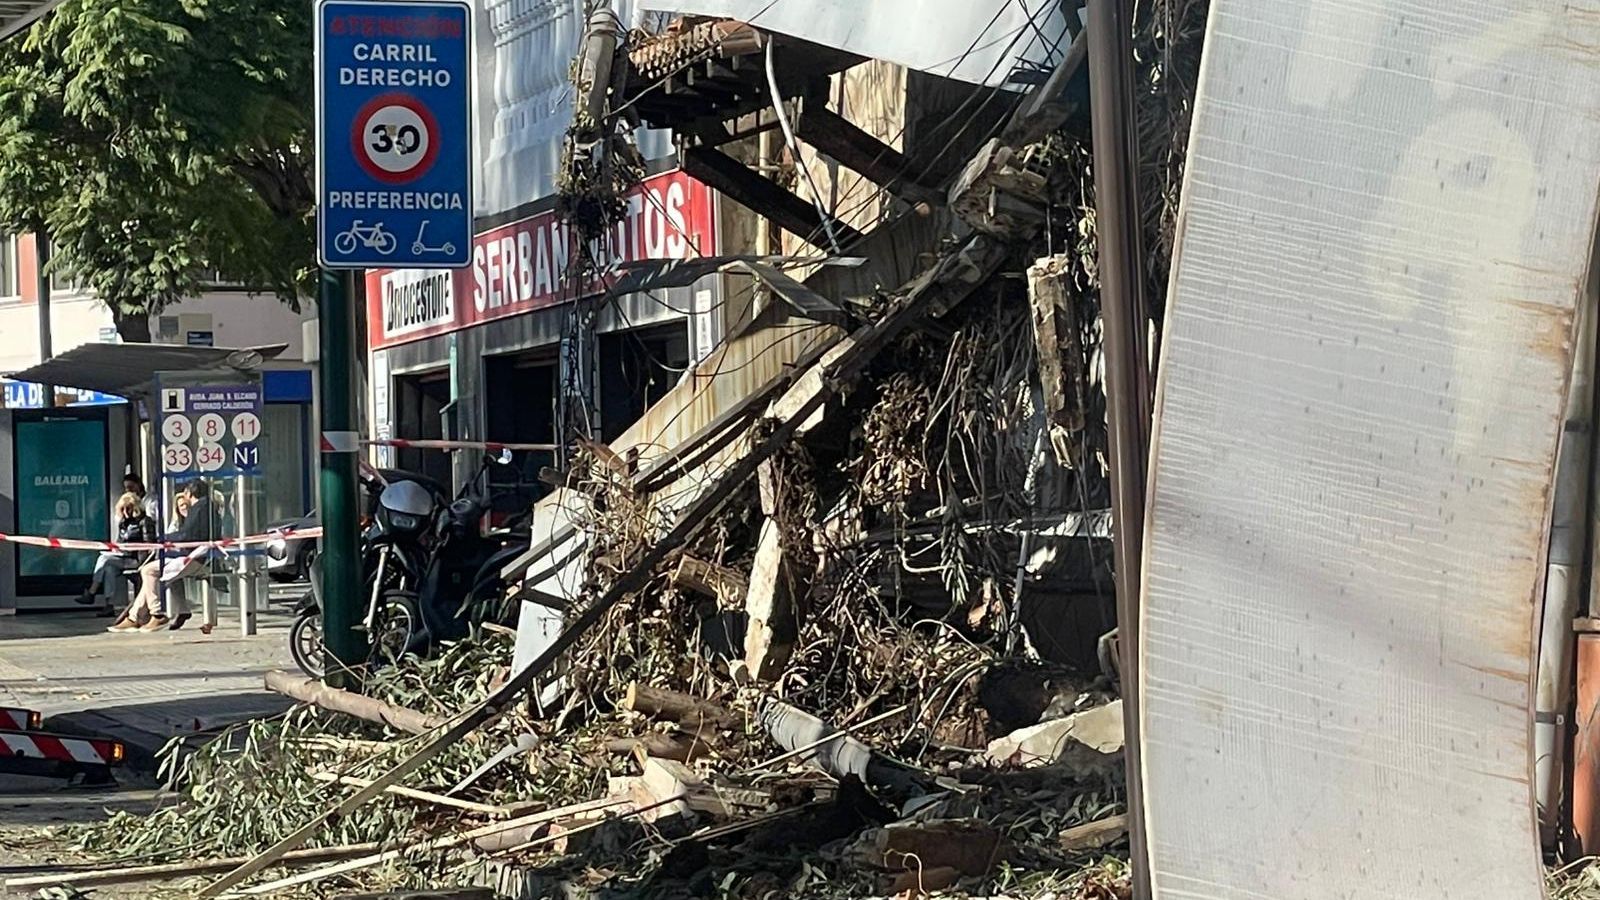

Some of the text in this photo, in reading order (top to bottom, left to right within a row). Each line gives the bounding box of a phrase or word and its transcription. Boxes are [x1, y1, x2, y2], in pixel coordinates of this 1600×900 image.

[353, 43, 437, 62] CARRIL
[339, 67, 451, 87] DERECHO
[371, 124, 420, 154] 30
[329, 191, 463, 209] PREFERENCIA
[387, 272, 449, 331] BRIDGESTONE
[171, 419, 255, 437] 3 8 11
[166, 447, 258, 466] 33 34 N1
